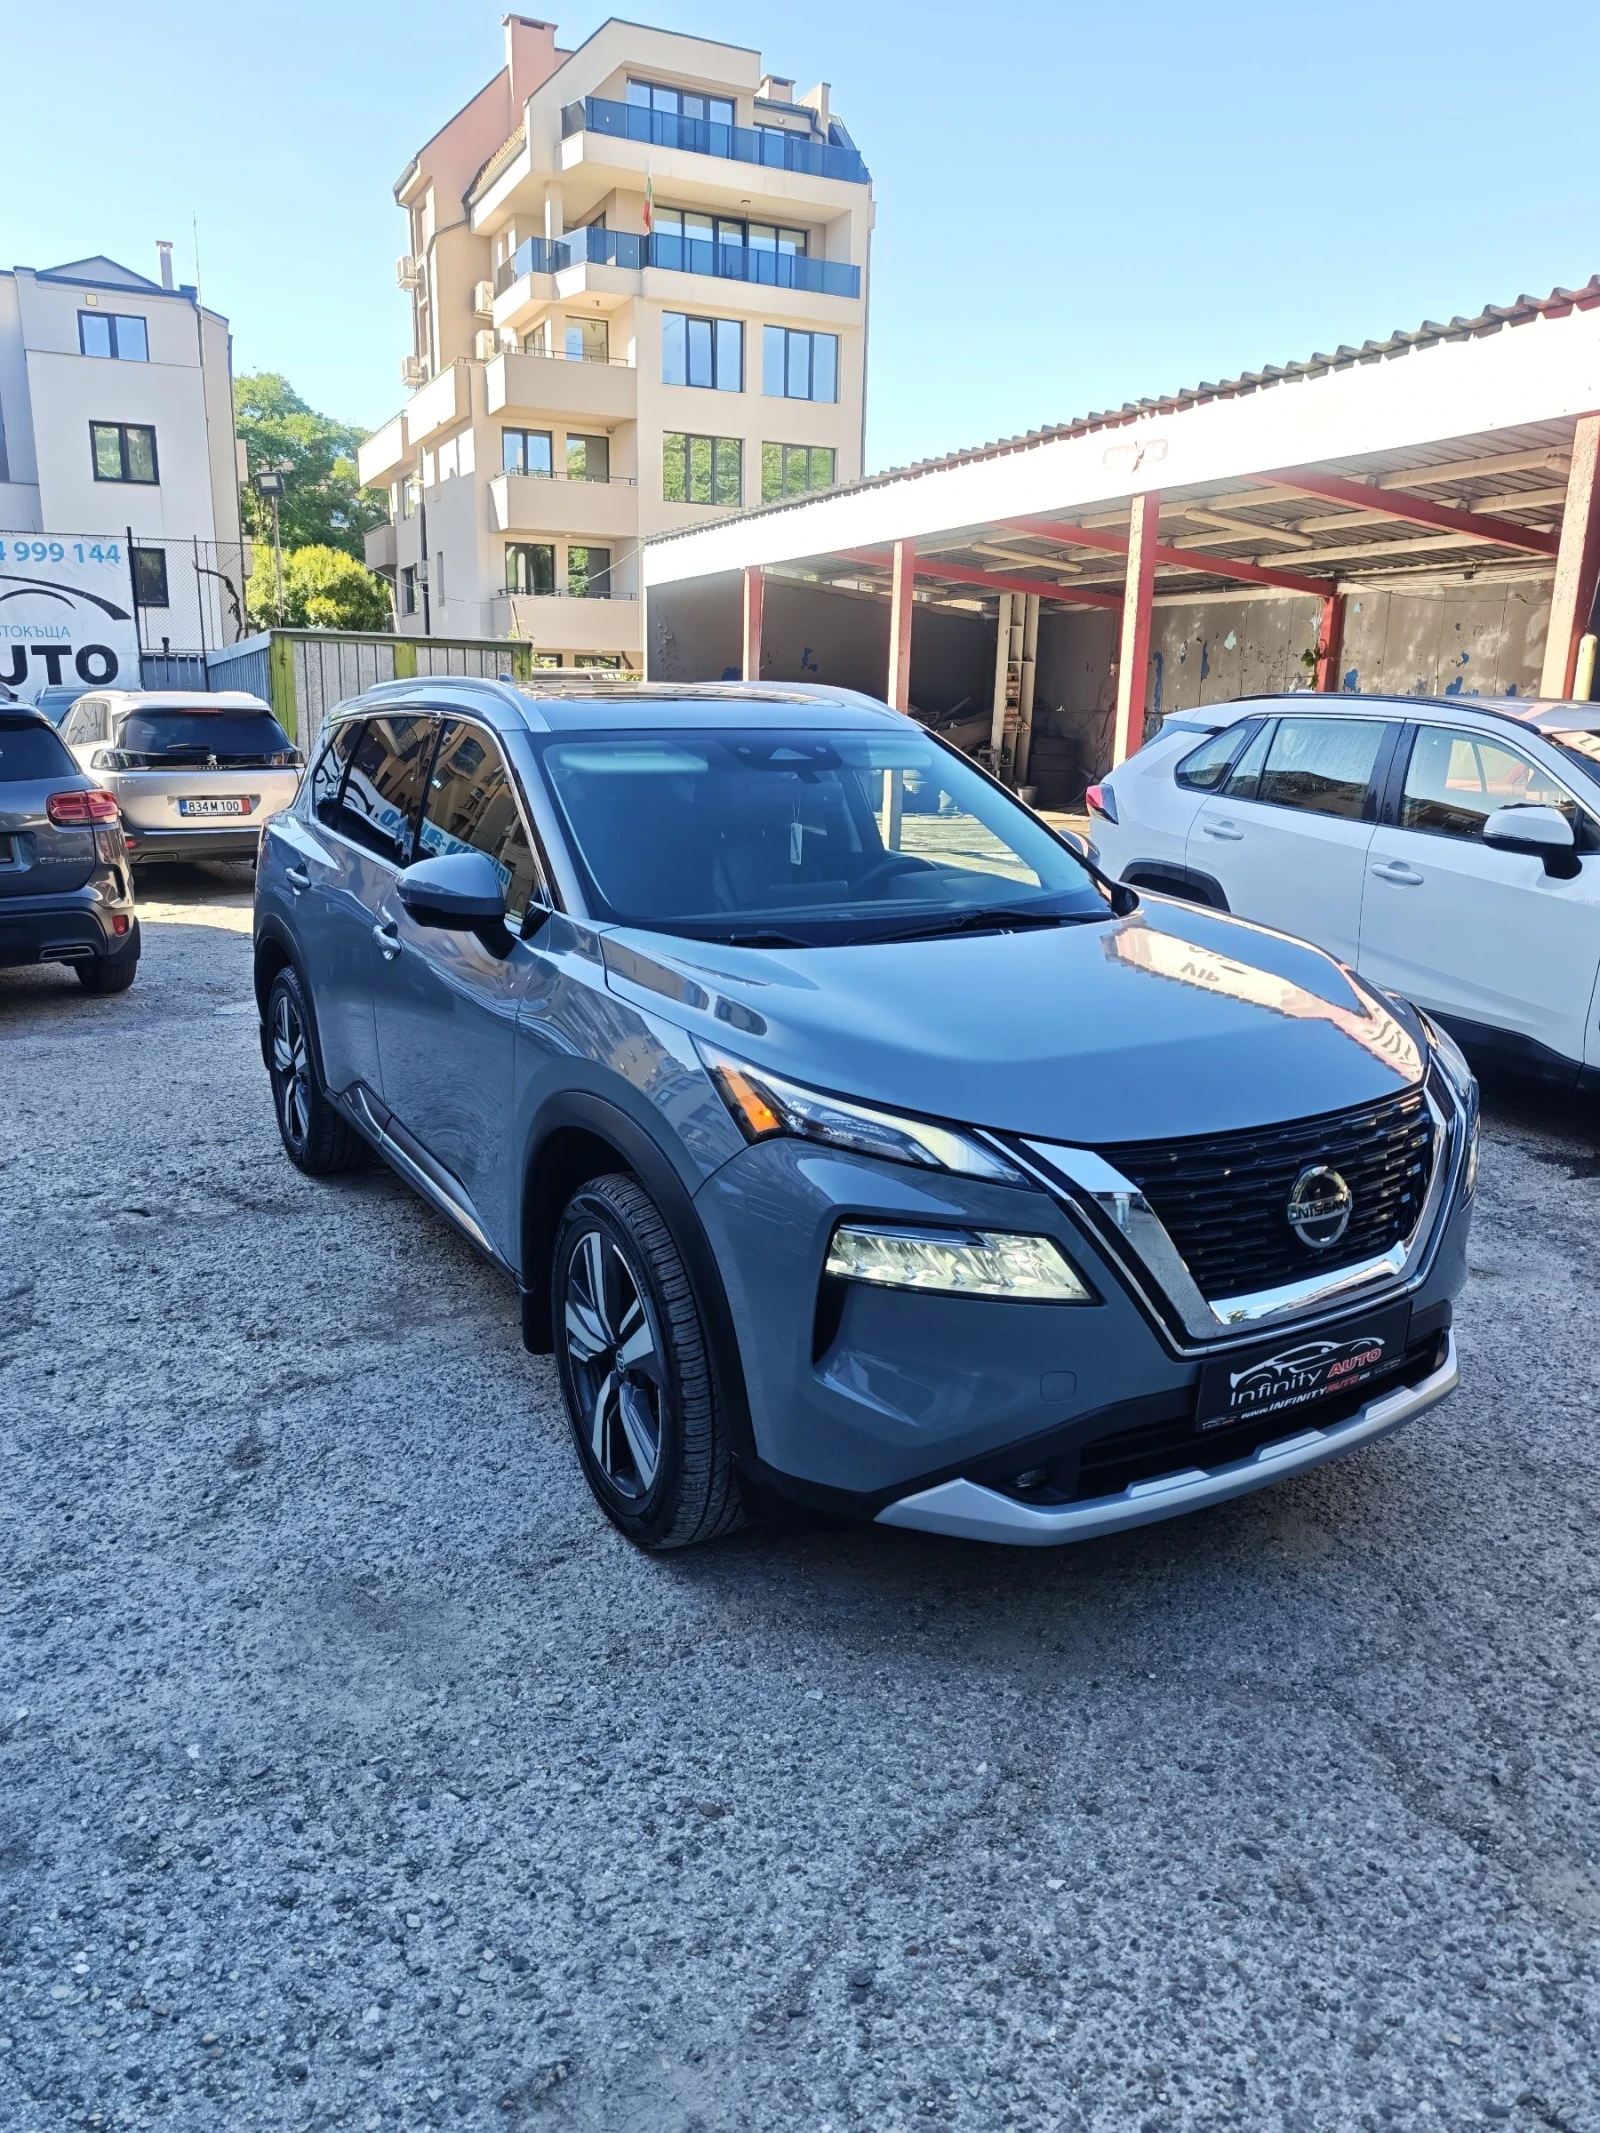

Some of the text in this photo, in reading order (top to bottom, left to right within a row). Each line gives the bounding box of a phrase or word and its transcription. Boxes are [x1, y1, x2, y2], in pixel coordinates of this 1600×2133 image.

[14, 541, 65, 562] 999
[73, 543, 121, 564] 144
[0, 625, 71, 640] ТОКЪЩА
[221, 801, 239, 811] 100
[1299, 1201, 1347, 1218] NISSAN
[1230, 1369, 1322, 1406] Infinity
[1327, 1348, 1382, 1378] AUTO
